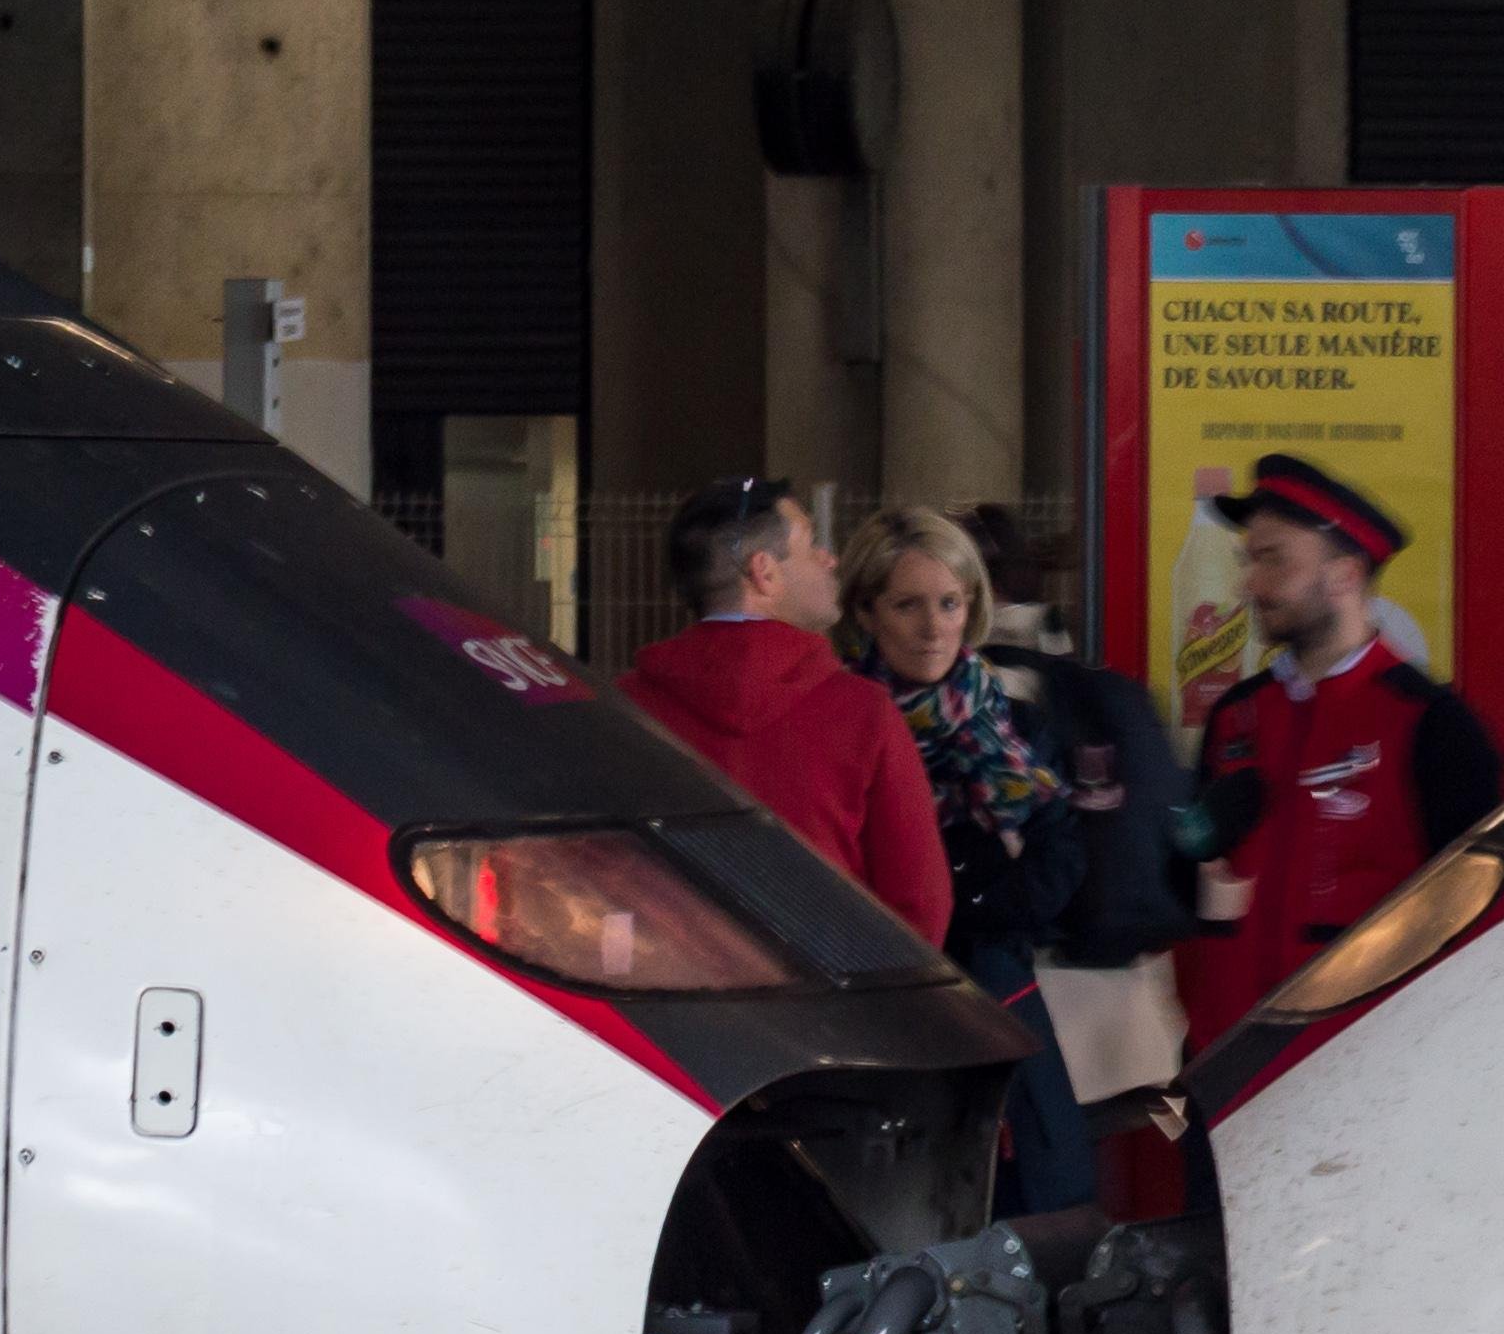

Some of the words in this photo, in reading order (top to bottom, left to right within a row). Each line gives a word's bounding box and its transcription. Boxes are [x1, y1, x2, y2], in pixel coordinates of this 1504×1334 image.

[1163, 300, 1275, 322] CHACUN
[1282, 301, 1314, 322] SA
[1322, 301, 1422, 325] ROUTE,
[1163, 334, 1219, 355] UNE
[1225, 334, 1310, 356] SEULE
[1163, 367, 1199, 389] DE
[1206, 368, 1355, 389] SAVOURER.
